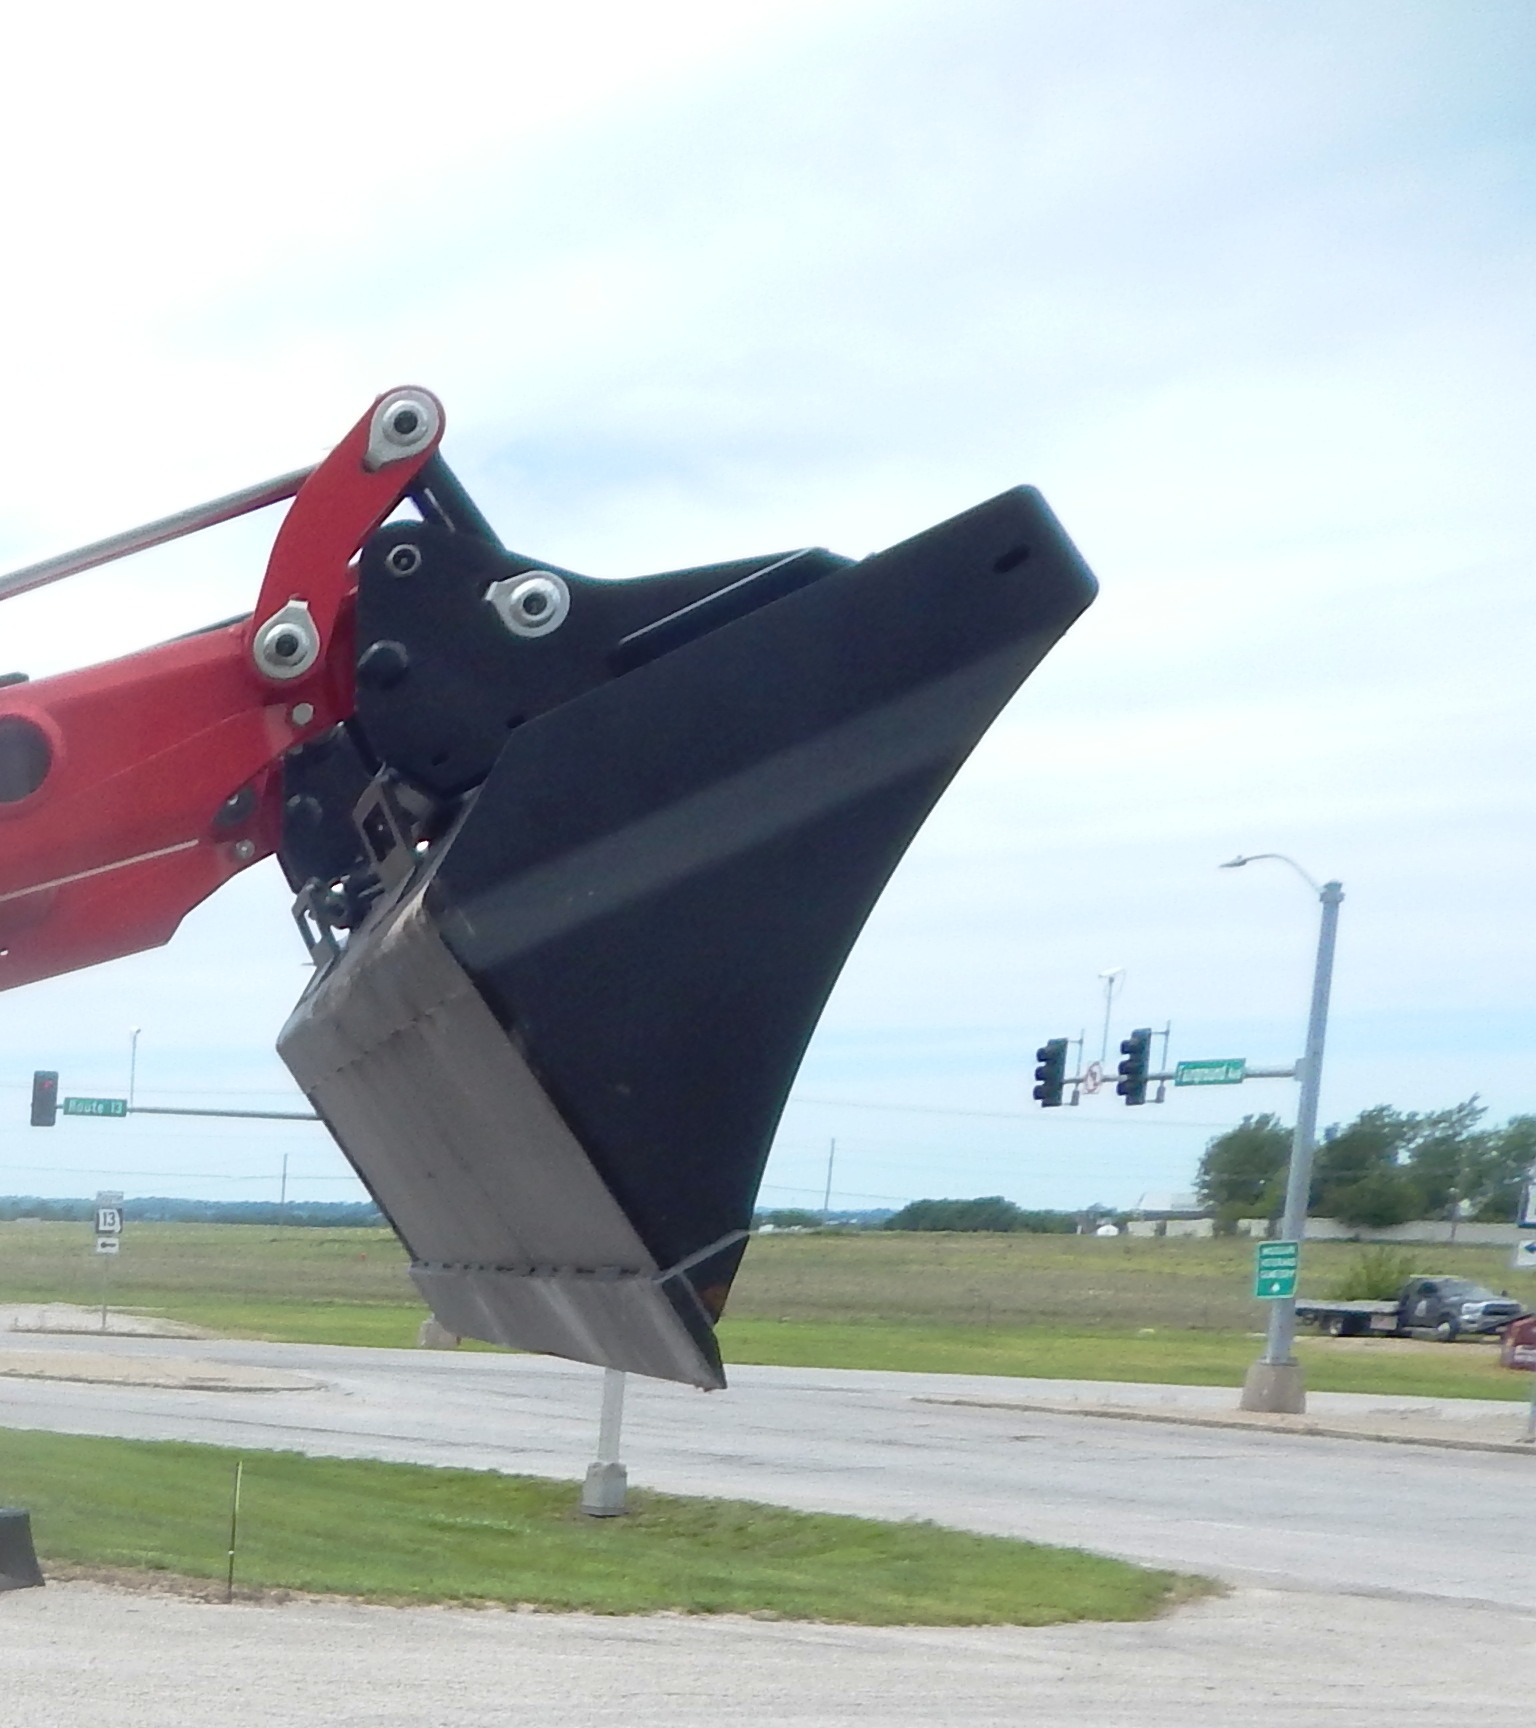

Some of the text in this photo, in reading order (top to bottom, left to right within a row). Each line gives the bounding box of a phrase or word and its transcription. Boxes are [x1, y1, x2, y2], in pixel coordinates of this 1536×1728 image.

[68, 1102, 123, 1115] Route 13
[102, 1211, 116, 1227] 13
